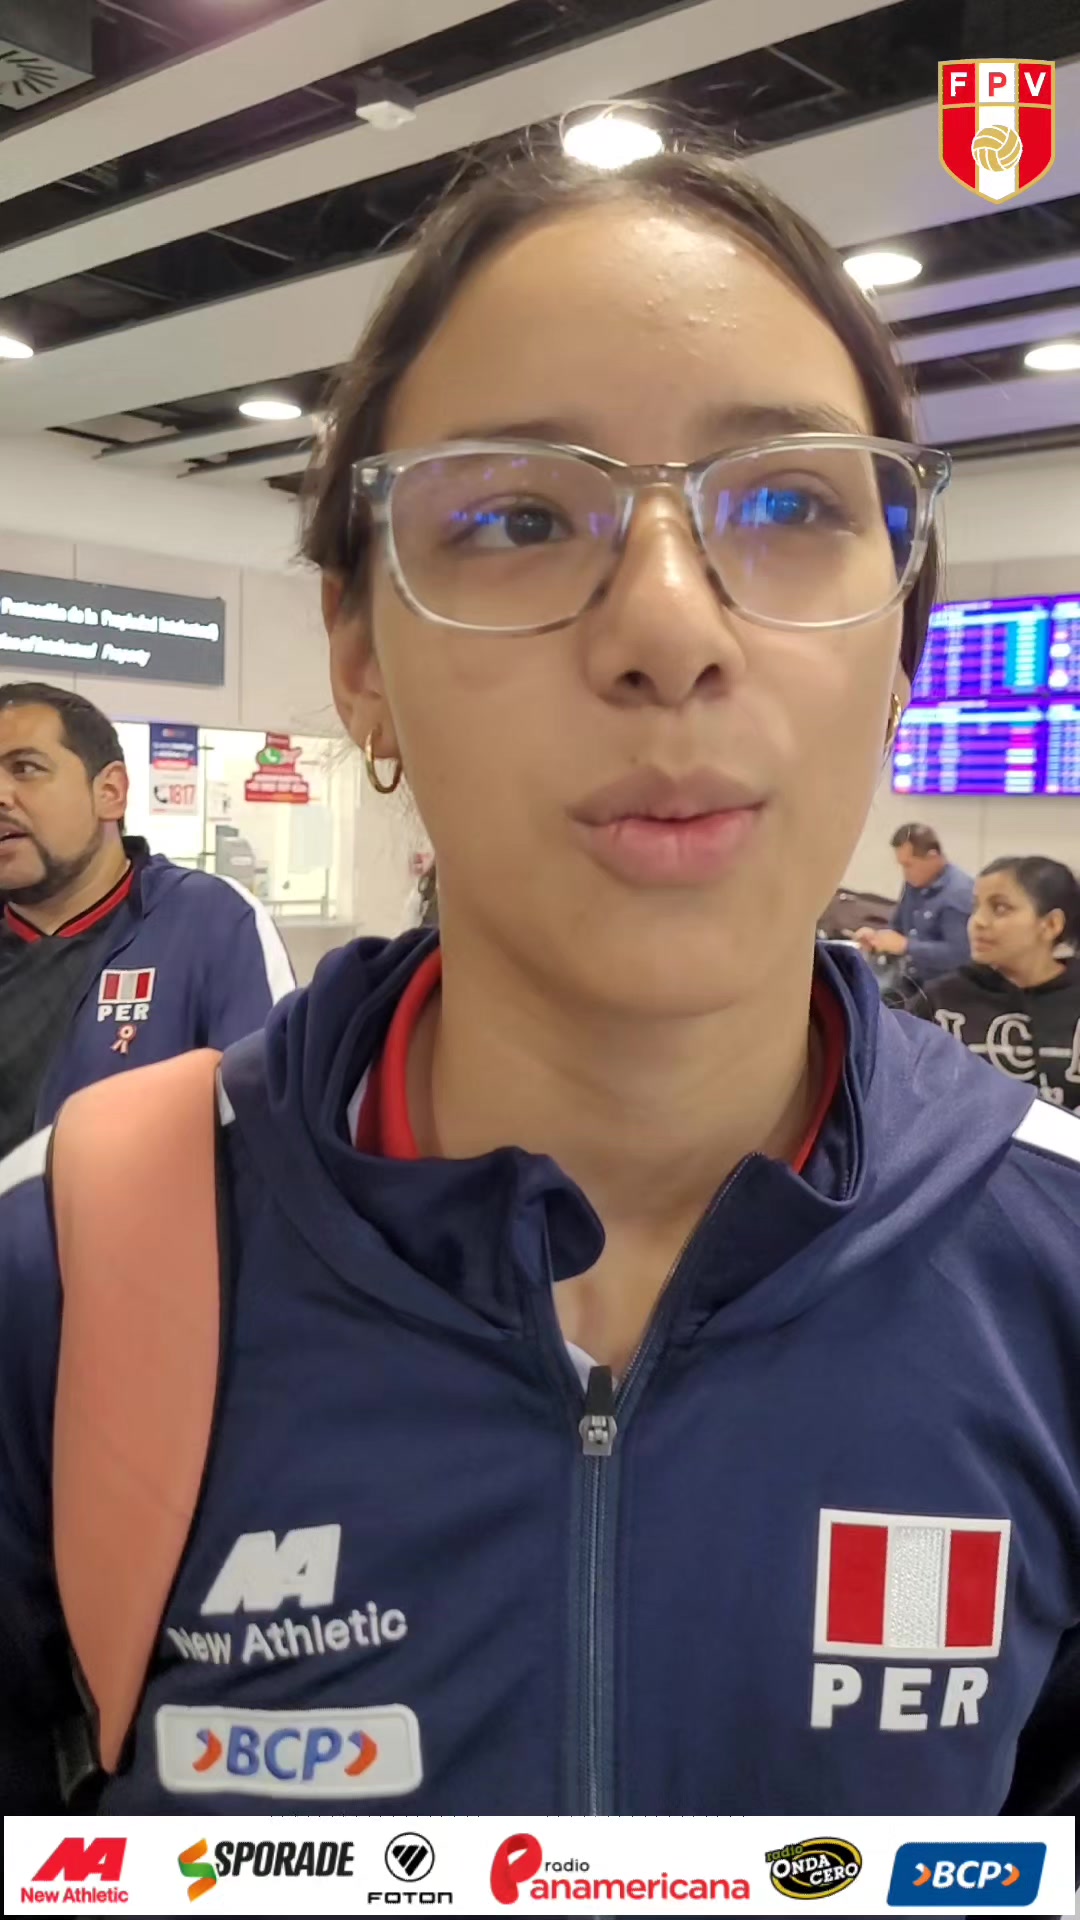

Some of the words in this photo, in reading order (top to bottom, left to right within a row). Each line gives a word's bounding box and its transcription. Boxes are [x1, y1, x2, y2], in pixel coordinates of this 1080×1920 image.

[169, 784, 196, 805] 1817
[97, 1003, 150, 1022] PER
[167, 1627, 231, 1664] New
[242, 1600, 408, 1663] Athletic
[810, 1662, 989, 1731] PER
[226, 1725, 343, 1781] BCP
